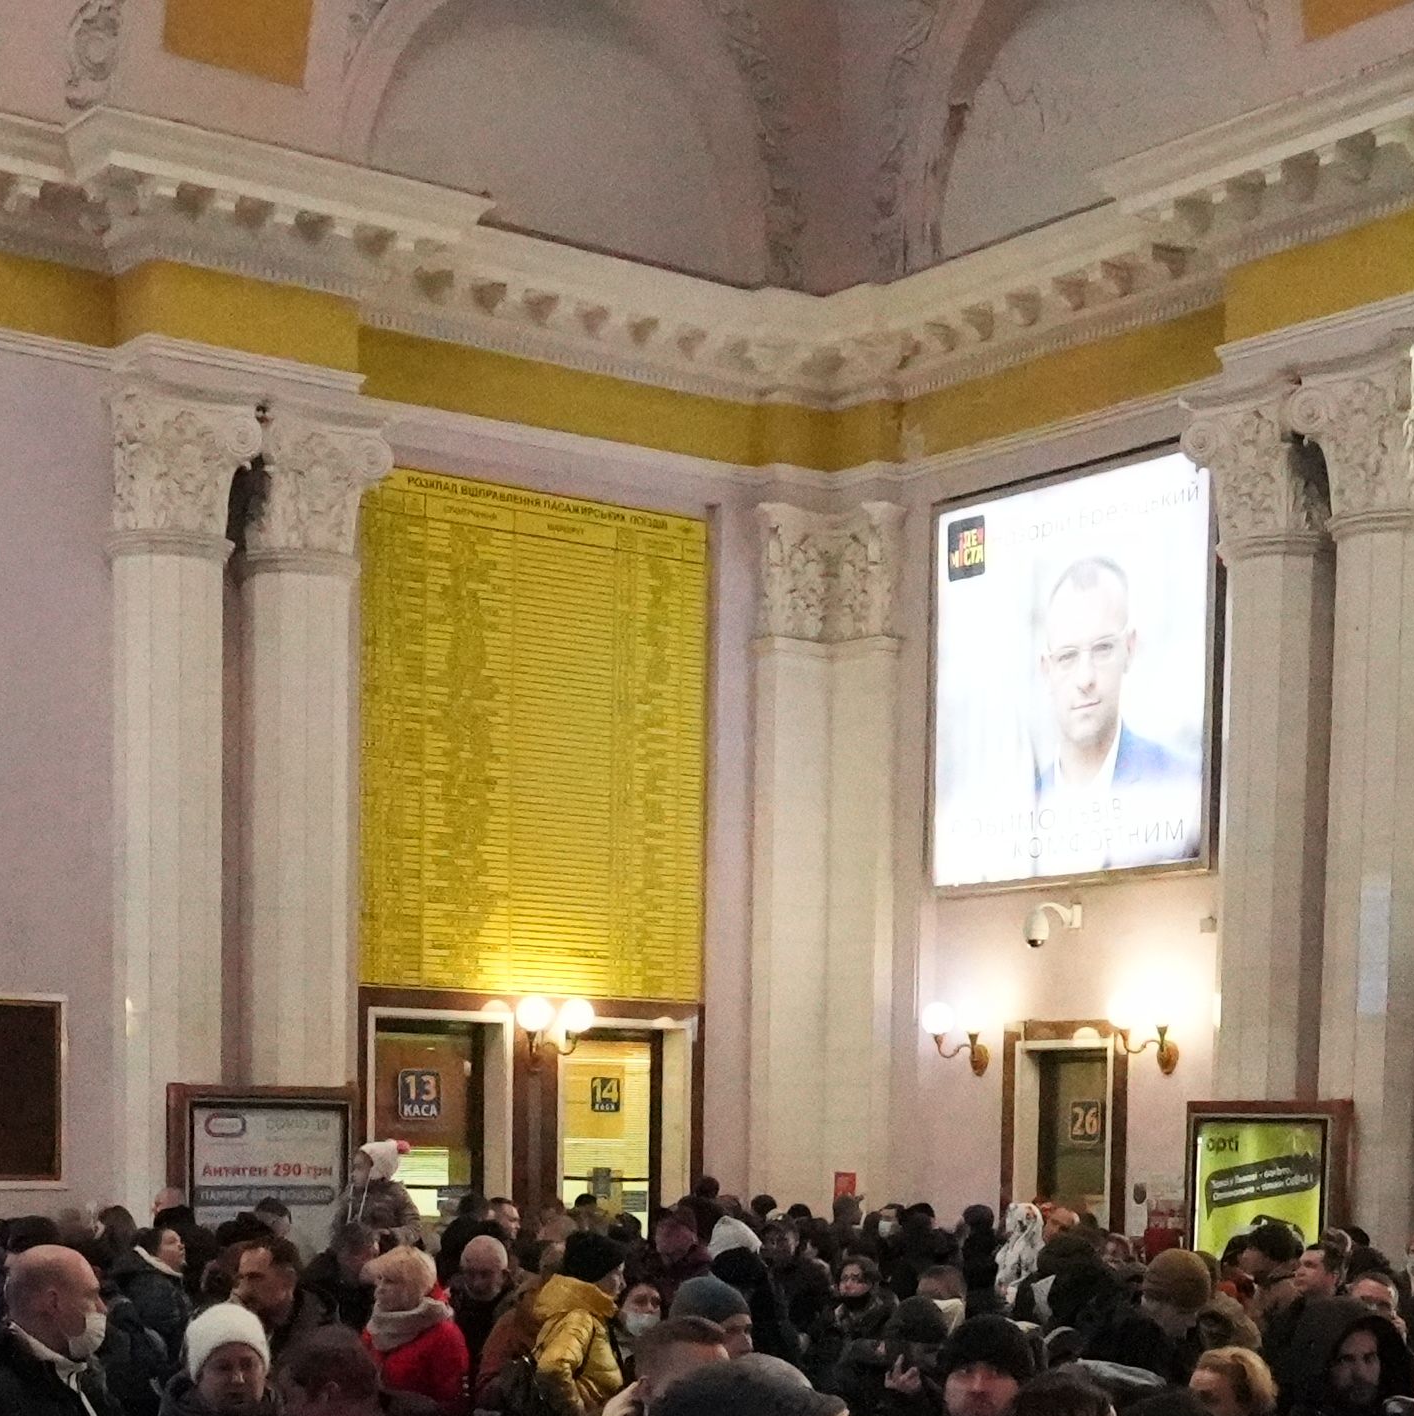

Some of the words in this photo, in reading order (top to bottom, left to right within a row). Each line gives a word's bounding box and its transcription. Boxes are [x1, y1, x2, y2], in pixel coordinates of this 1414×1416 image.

[406, 475, 459, 495] РОЗКЛАД
[404, 1074, 437, 1102] 13
[592, 1078, 619, 1103] 14
[403, 1103, 438, 1117] КАСА
[1071, 1106, 1098, 1136] 26
[202, 1162, 268, 1177] Антиген
[272, 1162, 302, 1177] 290
[304, 1166, 333, 1180] грн
